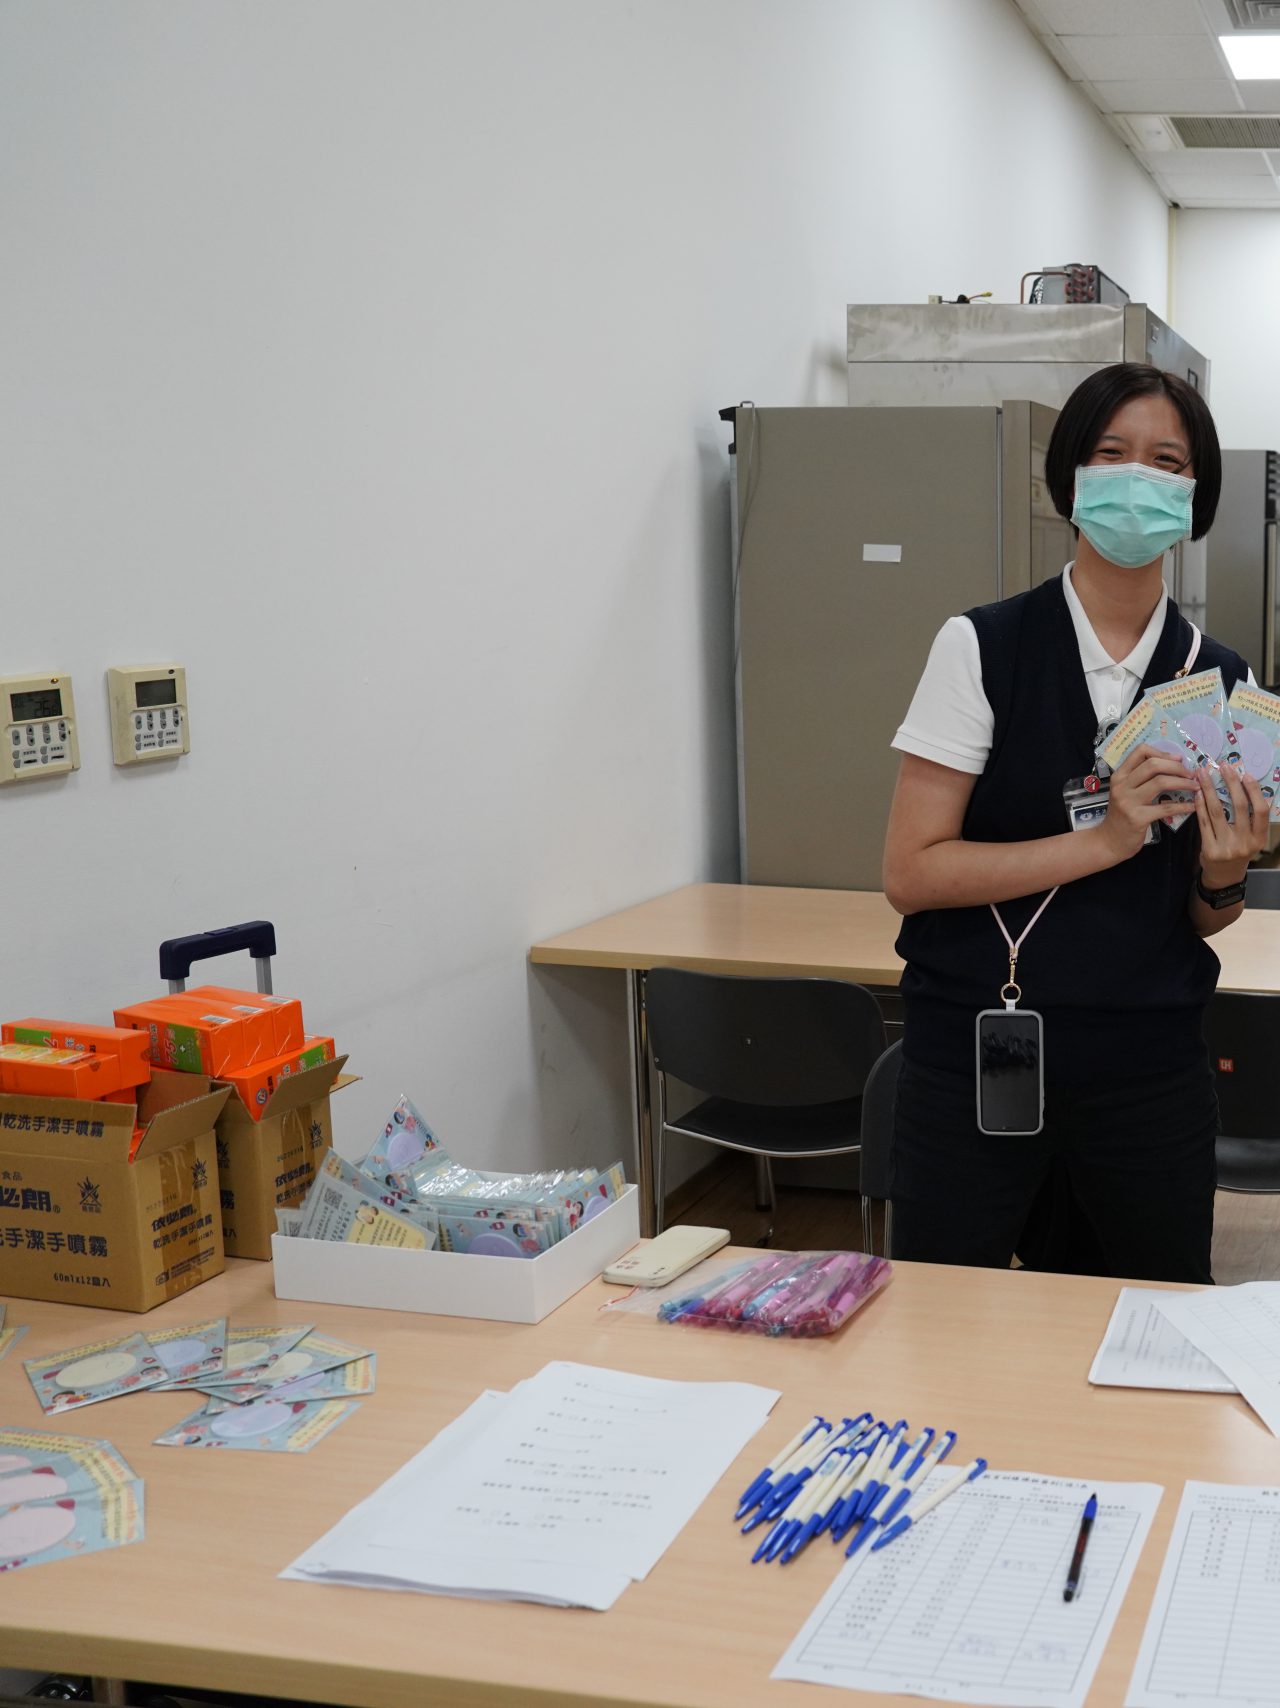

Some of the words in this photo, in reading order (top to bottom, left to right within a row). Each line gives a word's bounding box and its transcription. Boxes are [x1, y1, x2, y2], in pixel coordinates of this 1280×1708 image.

[0, 1112, 105, 1138] 乾洗手潔手噴霧
